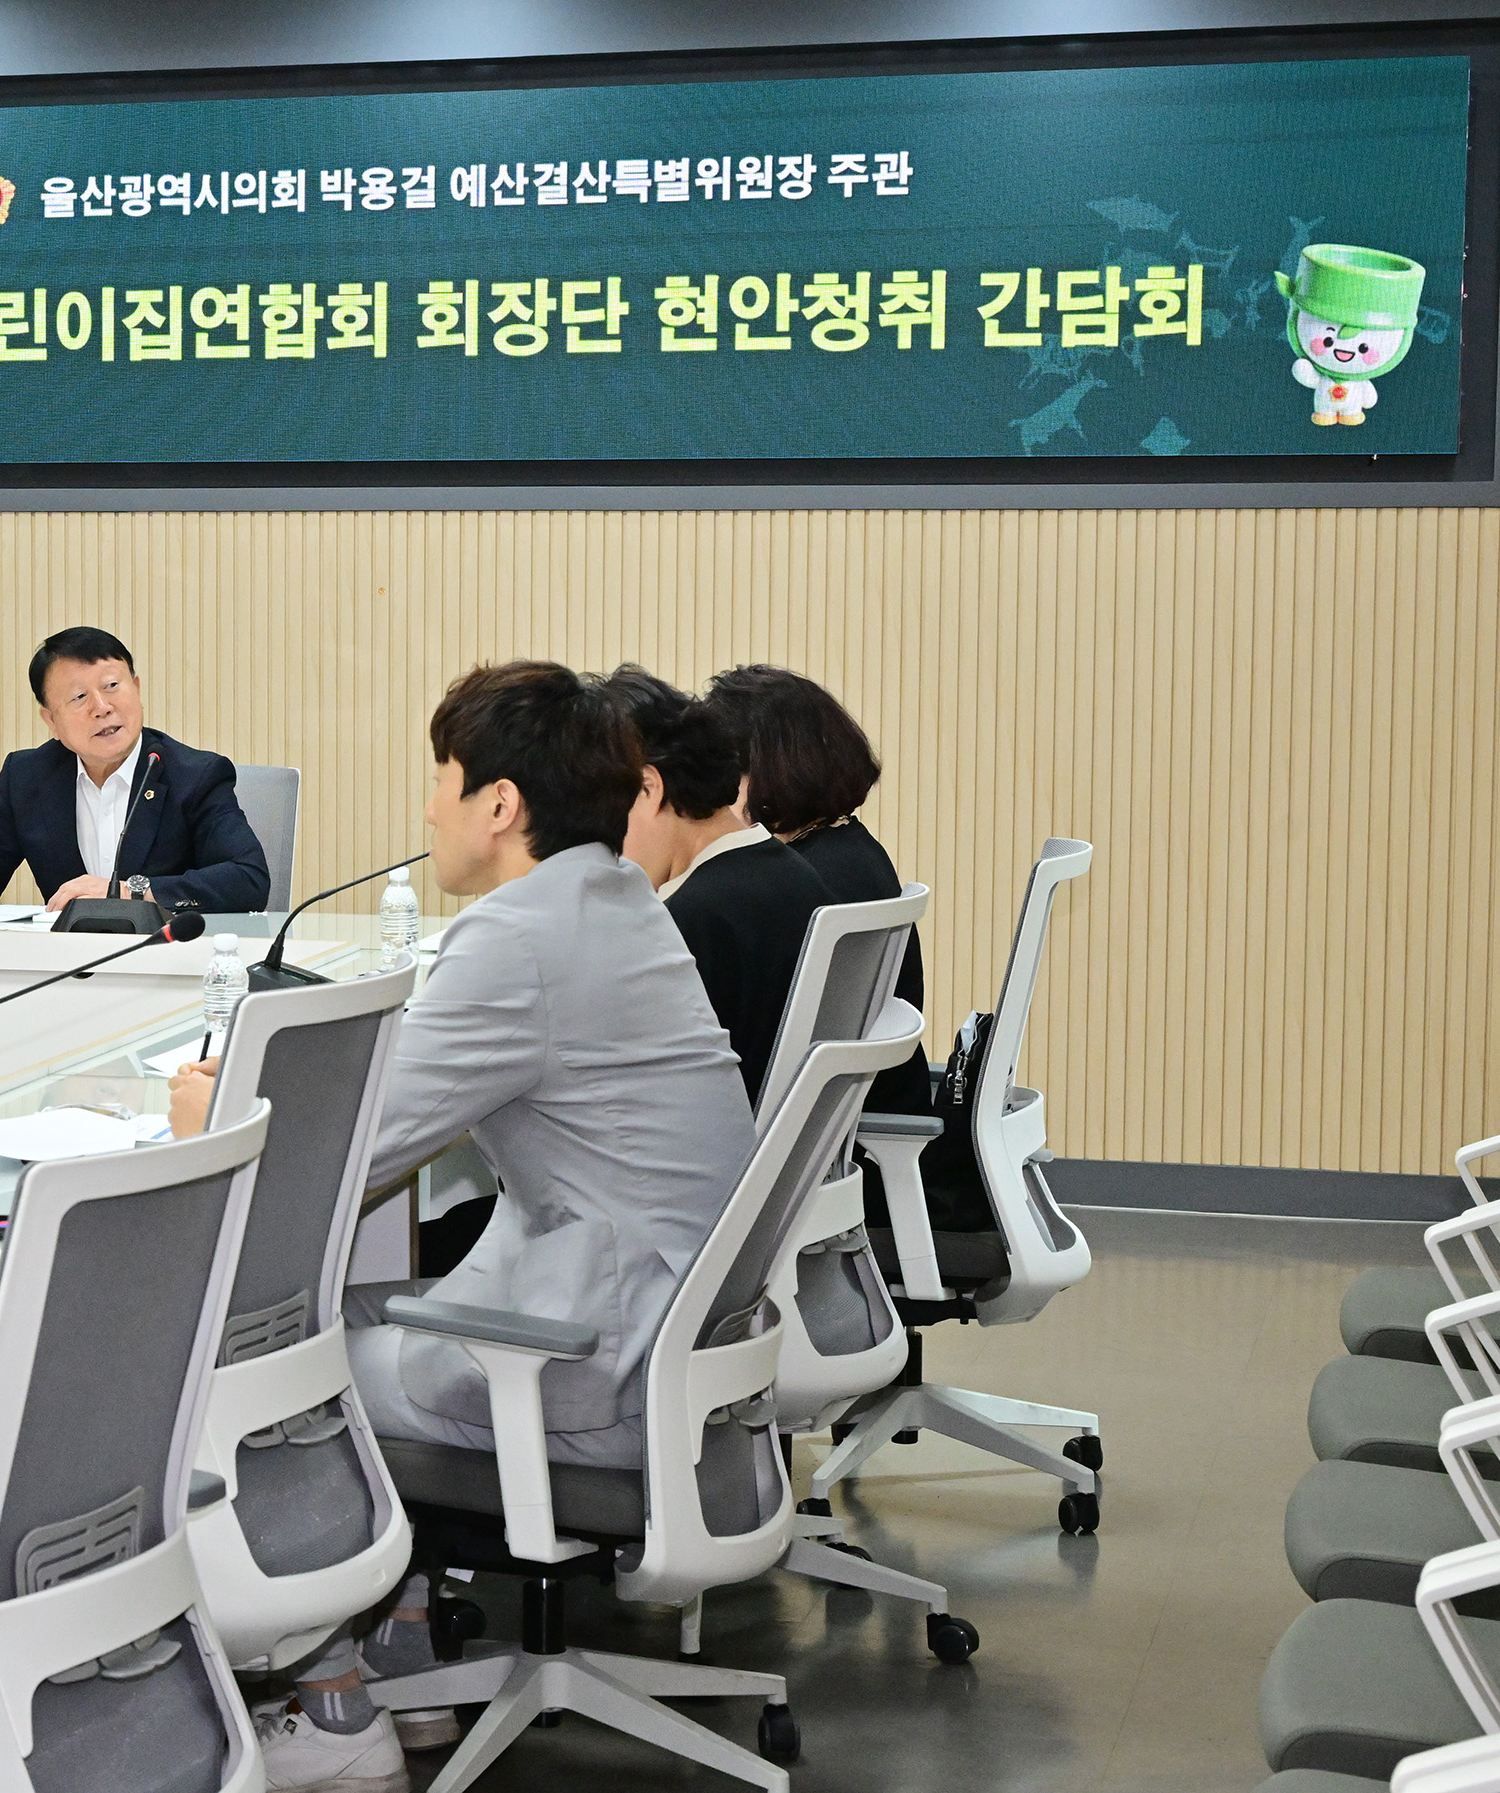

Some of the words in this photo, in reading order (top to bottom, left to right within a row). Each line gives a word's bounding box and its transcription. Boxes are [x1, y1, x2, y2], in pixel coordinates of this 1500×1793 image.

[40, 167, 306, 218] 울산광역시의회
[320, 164, 436, 212] 박용걸
[450, 154, 817, 208] 예산결산특별위원장
[827, 150, 914, 198] 주관
[416, 276, 629, 358] 회장단
[654, 269, 947, 353] 현안청취
[978, 264, 1204, 348] 간담회
